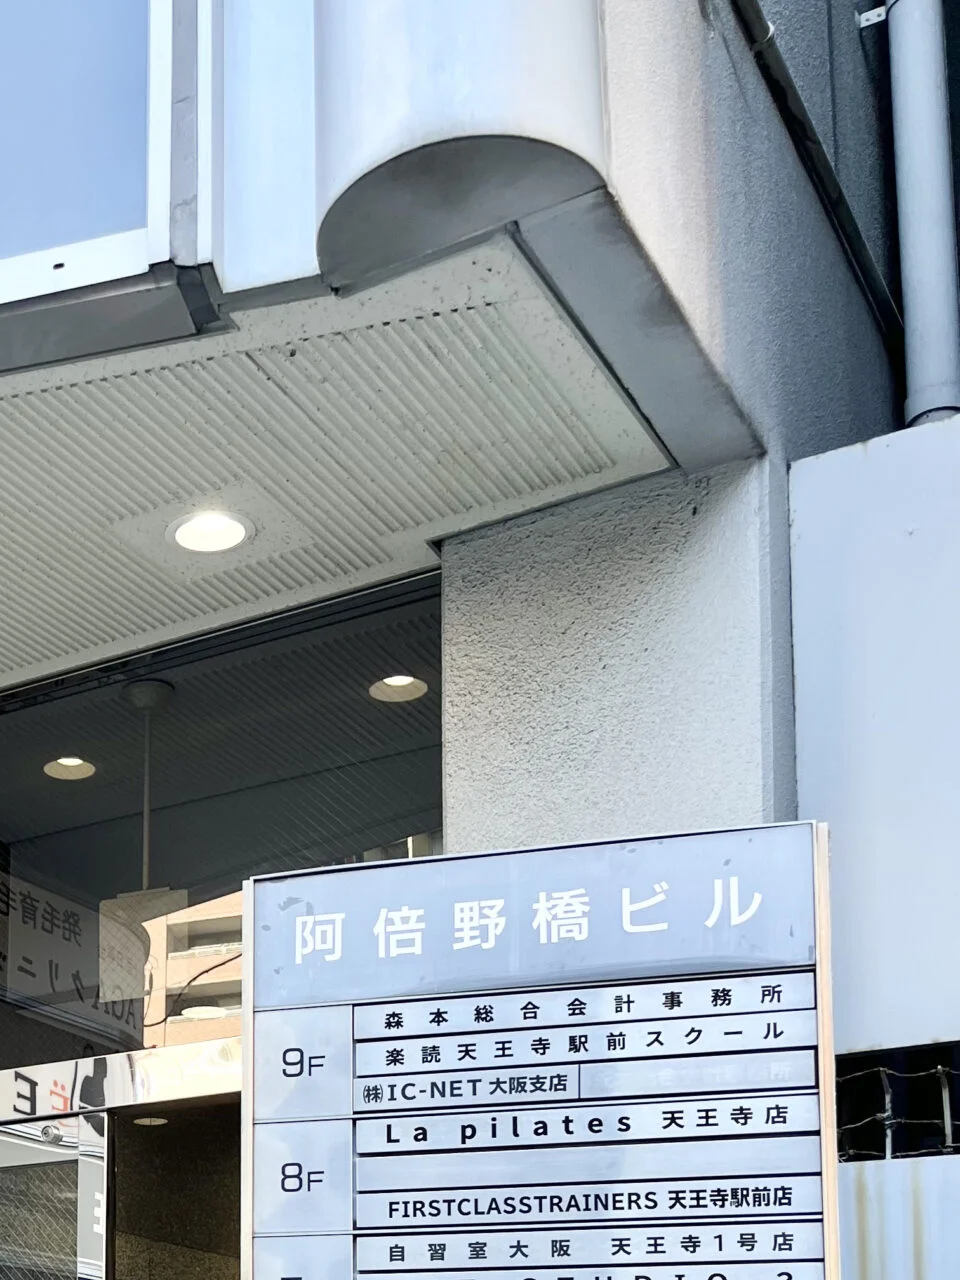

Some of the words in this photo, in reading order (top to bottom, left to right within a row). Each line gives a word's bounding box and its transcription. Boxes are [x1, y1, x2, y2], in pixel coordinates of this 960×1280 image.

[294, 876, 763, 964] 阿倍野橋ビル
[383, 983, 784, 1030] 森本総合会計事務所
[385, 1021, 786, 1067] 楽読天王寺駅前スクール
[282, 1048, 325, 1078] 9F
[488, 1073, 568, 1097] 大阪支店
[385, 1121, 429, 1144] La
[460, 1112, 633, 1145] pilates
[662, 1103, 790, 1130] 天王寺店
[280, 1163, 325, 1194] 8F
[387, 1191, 659, 1220] FIRSTCLASSTRAINERS
[667, 1186, 793, 1211] 天王寺駅前店
[388, 1238, 571, 1262] 自習室大阪
[610, 1230, 795, 1257] 天王寺1号店
